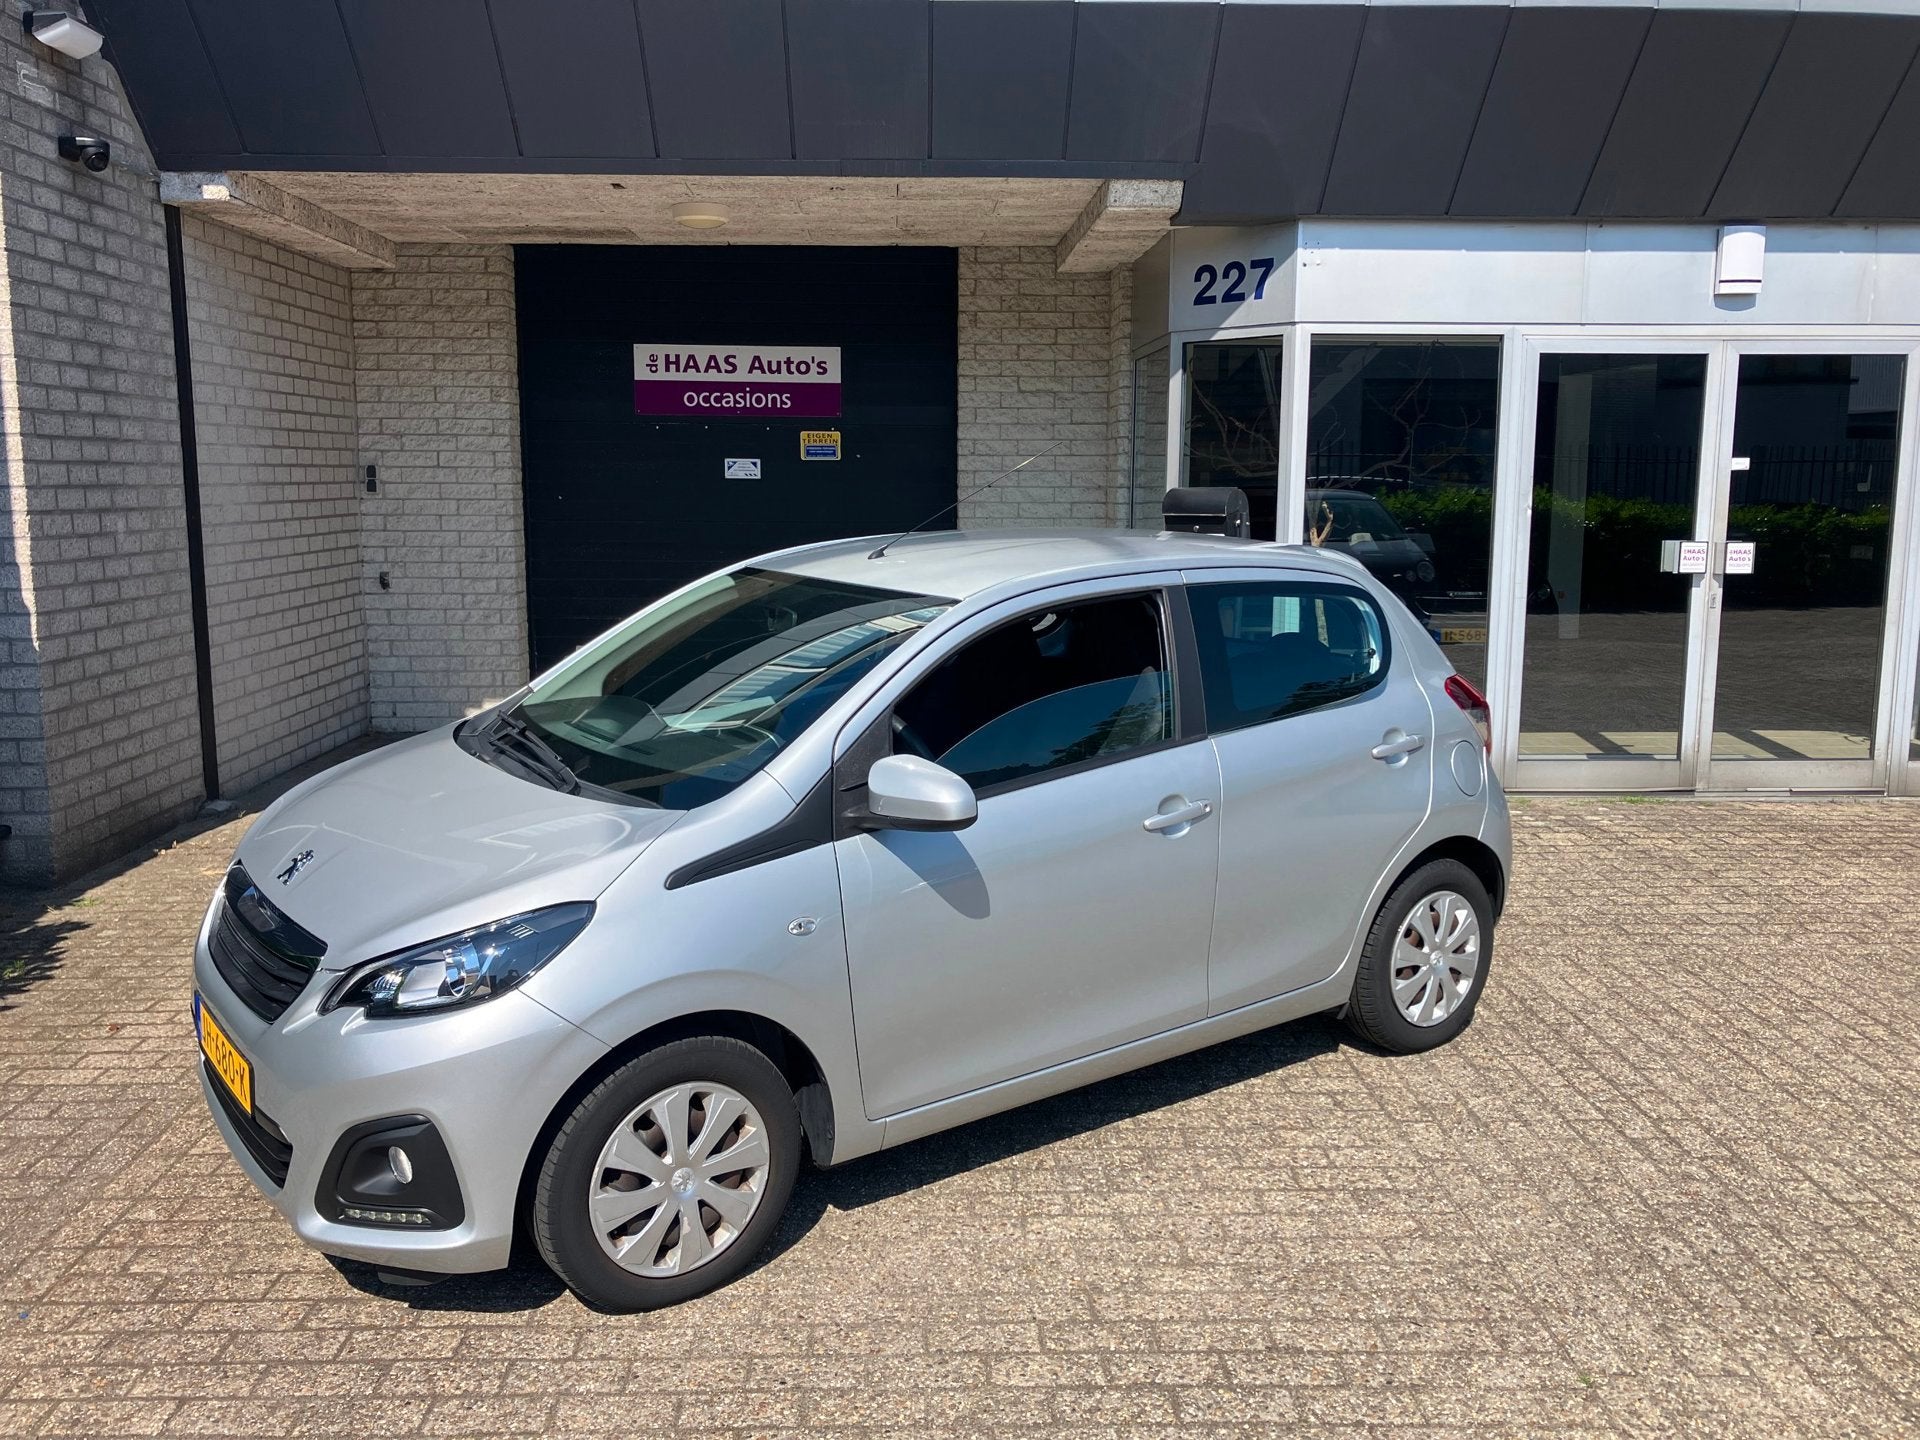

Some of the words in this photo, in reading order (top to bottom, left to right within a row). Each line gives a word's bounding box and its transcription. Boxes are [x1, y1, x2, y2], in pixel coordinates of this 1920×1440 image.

[1193, 257, 1274, 305] 227
[645, 353, 659, 374] de
[664, 353, 738, 374] HAAS
[748, 355, 828, 376] Auto's
[683, 387, 792, 408] occasions
